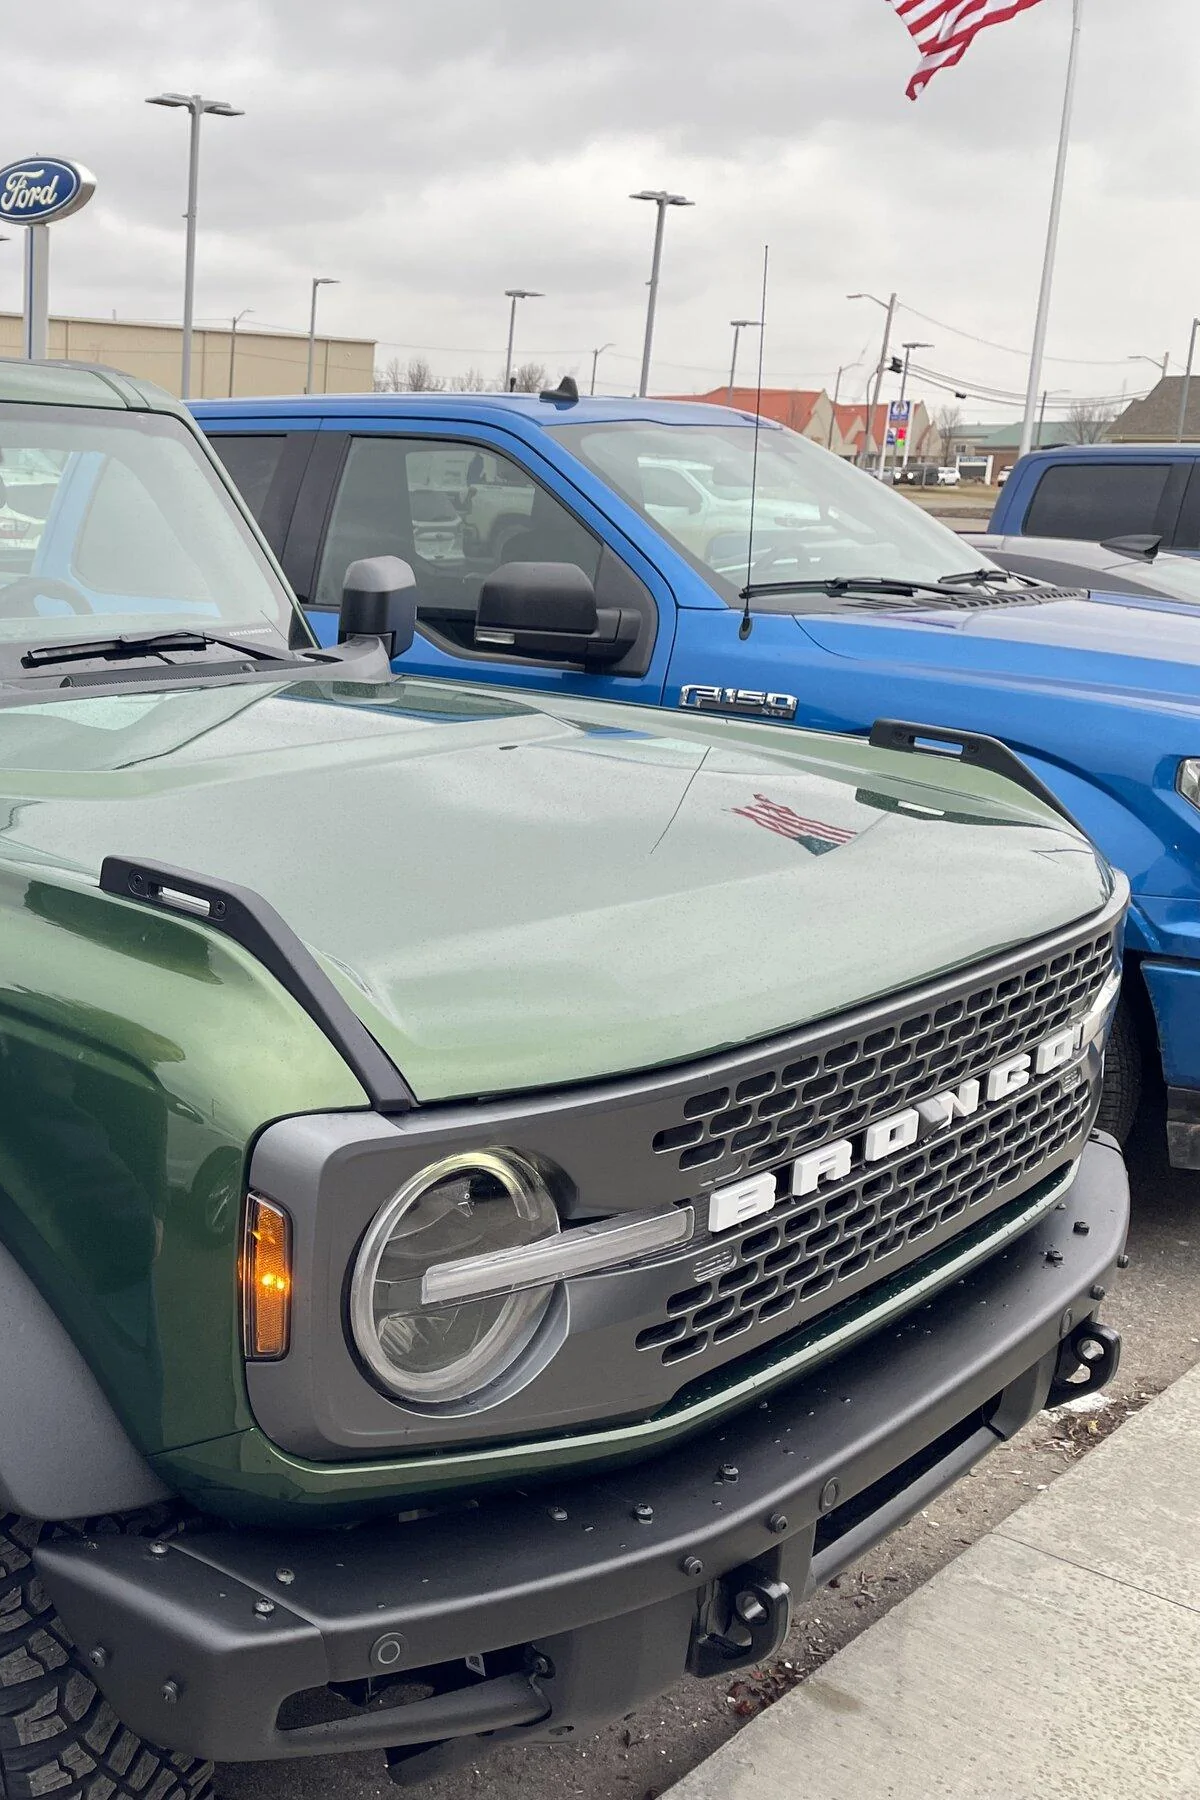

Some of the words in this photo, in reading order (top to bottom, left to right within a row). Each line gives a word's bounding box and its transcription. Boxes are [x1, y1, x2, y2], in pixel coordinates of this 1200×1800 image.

[1, 169, 59, 211] Ford
[761, 708, 786, 717] XLT
[708, 1029, 1074, 1233] BRONCO
